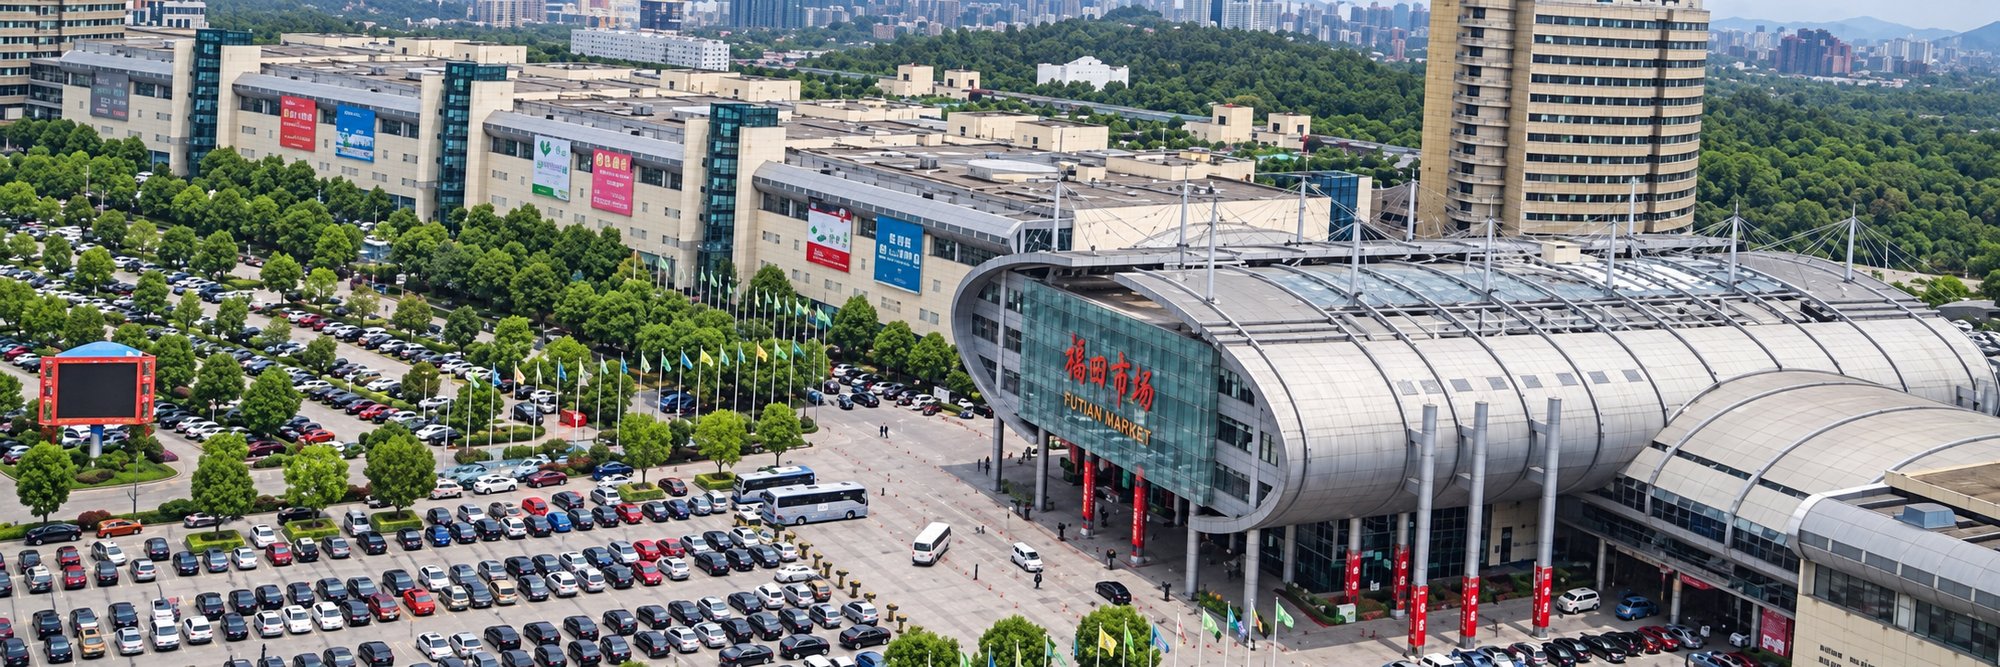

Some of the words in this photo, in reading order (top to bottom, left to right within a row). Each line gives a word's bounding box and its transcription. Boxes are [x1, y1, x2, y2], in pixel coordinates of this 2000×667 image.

[1065, 333, 1154, 411] 福田市场
[1064, 392, 1102, 422] FUTIAN
[1106, 411, 1152, 445] MARKET
